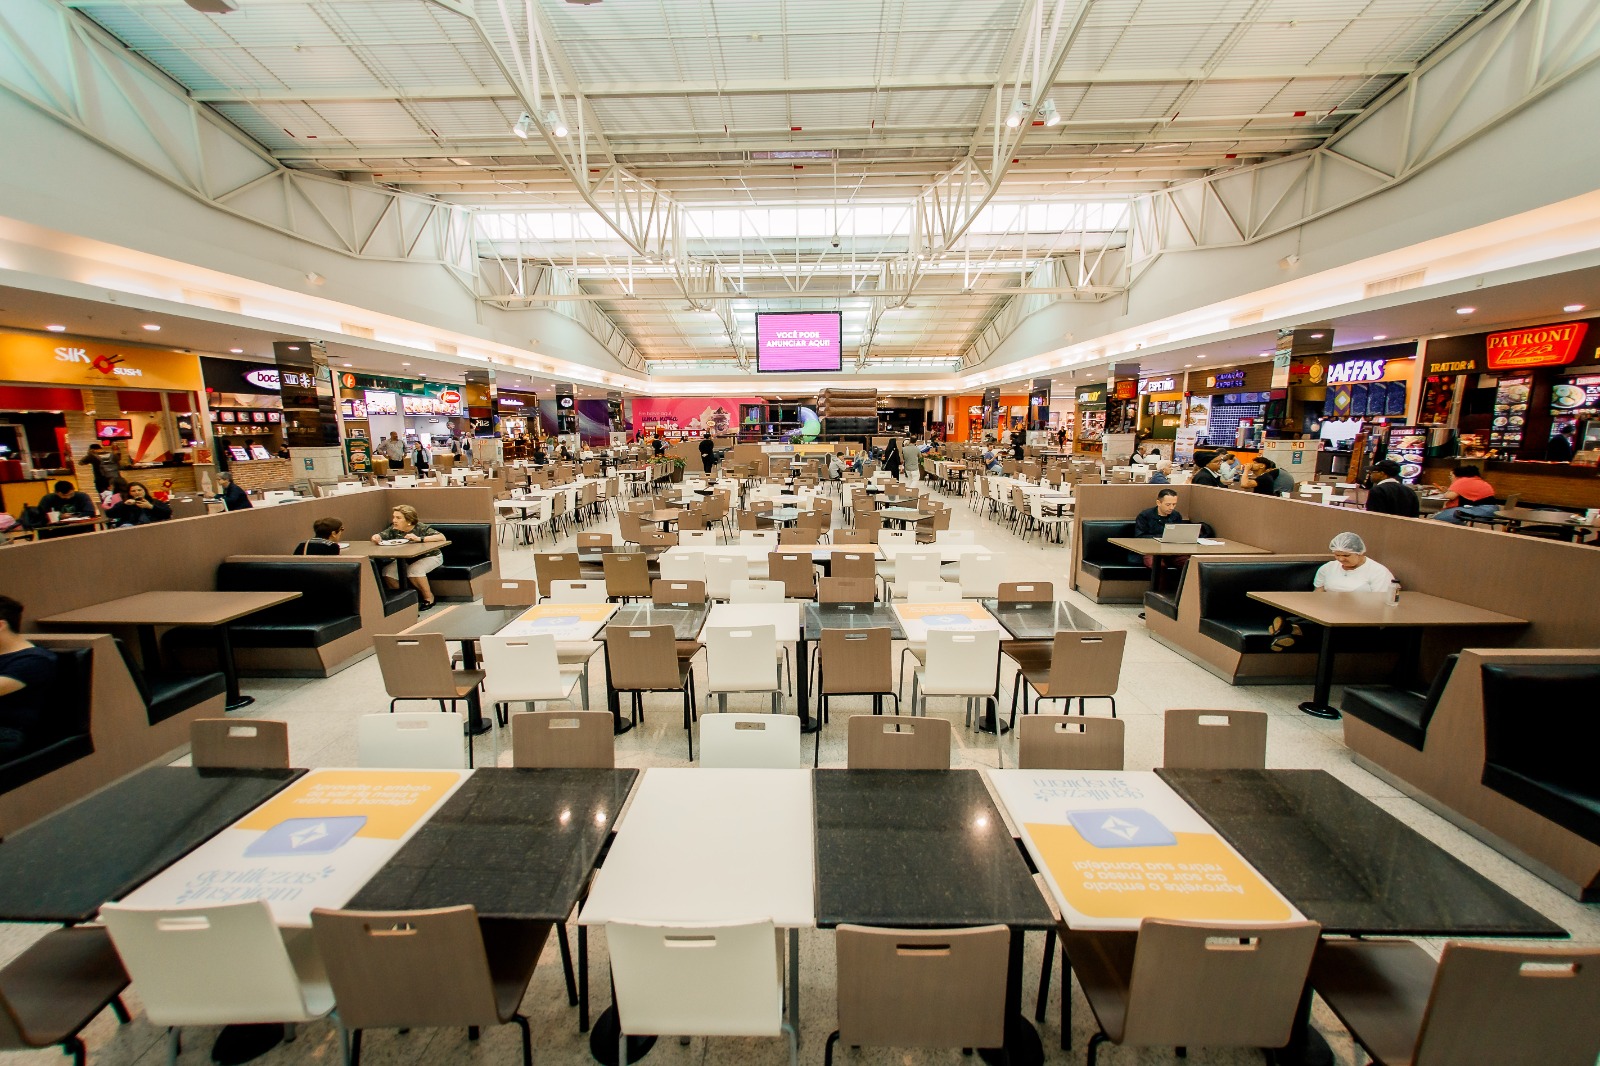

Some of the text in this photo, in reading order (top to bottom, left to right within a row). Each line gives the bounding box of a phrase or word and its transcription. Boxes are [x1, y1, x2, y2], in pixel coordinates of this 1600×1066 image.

[776, 330, 820, 339] VOCÊ PODE
[1488, 327, 1572, 349] PATRONI
[766, 340, 807, 348] ANUNCIAR
[1430, 359, 1476, 373] TRATTORA
[113, 367, 142, 377] SUSHI
[1216, 369, 1246, 382] CAMARÃO
[310, 784, 372, 792] Aproveite
[383, 784, 432, 792] embalo
[357, 797, 416, 806] bandeja!
[1072, 860, 1223, 872] retire sua bandeja!
[1083, 871, 1228, 882] ao sair da mesa e
[1083, 881, 1244, 895] Aproveite o embalo
